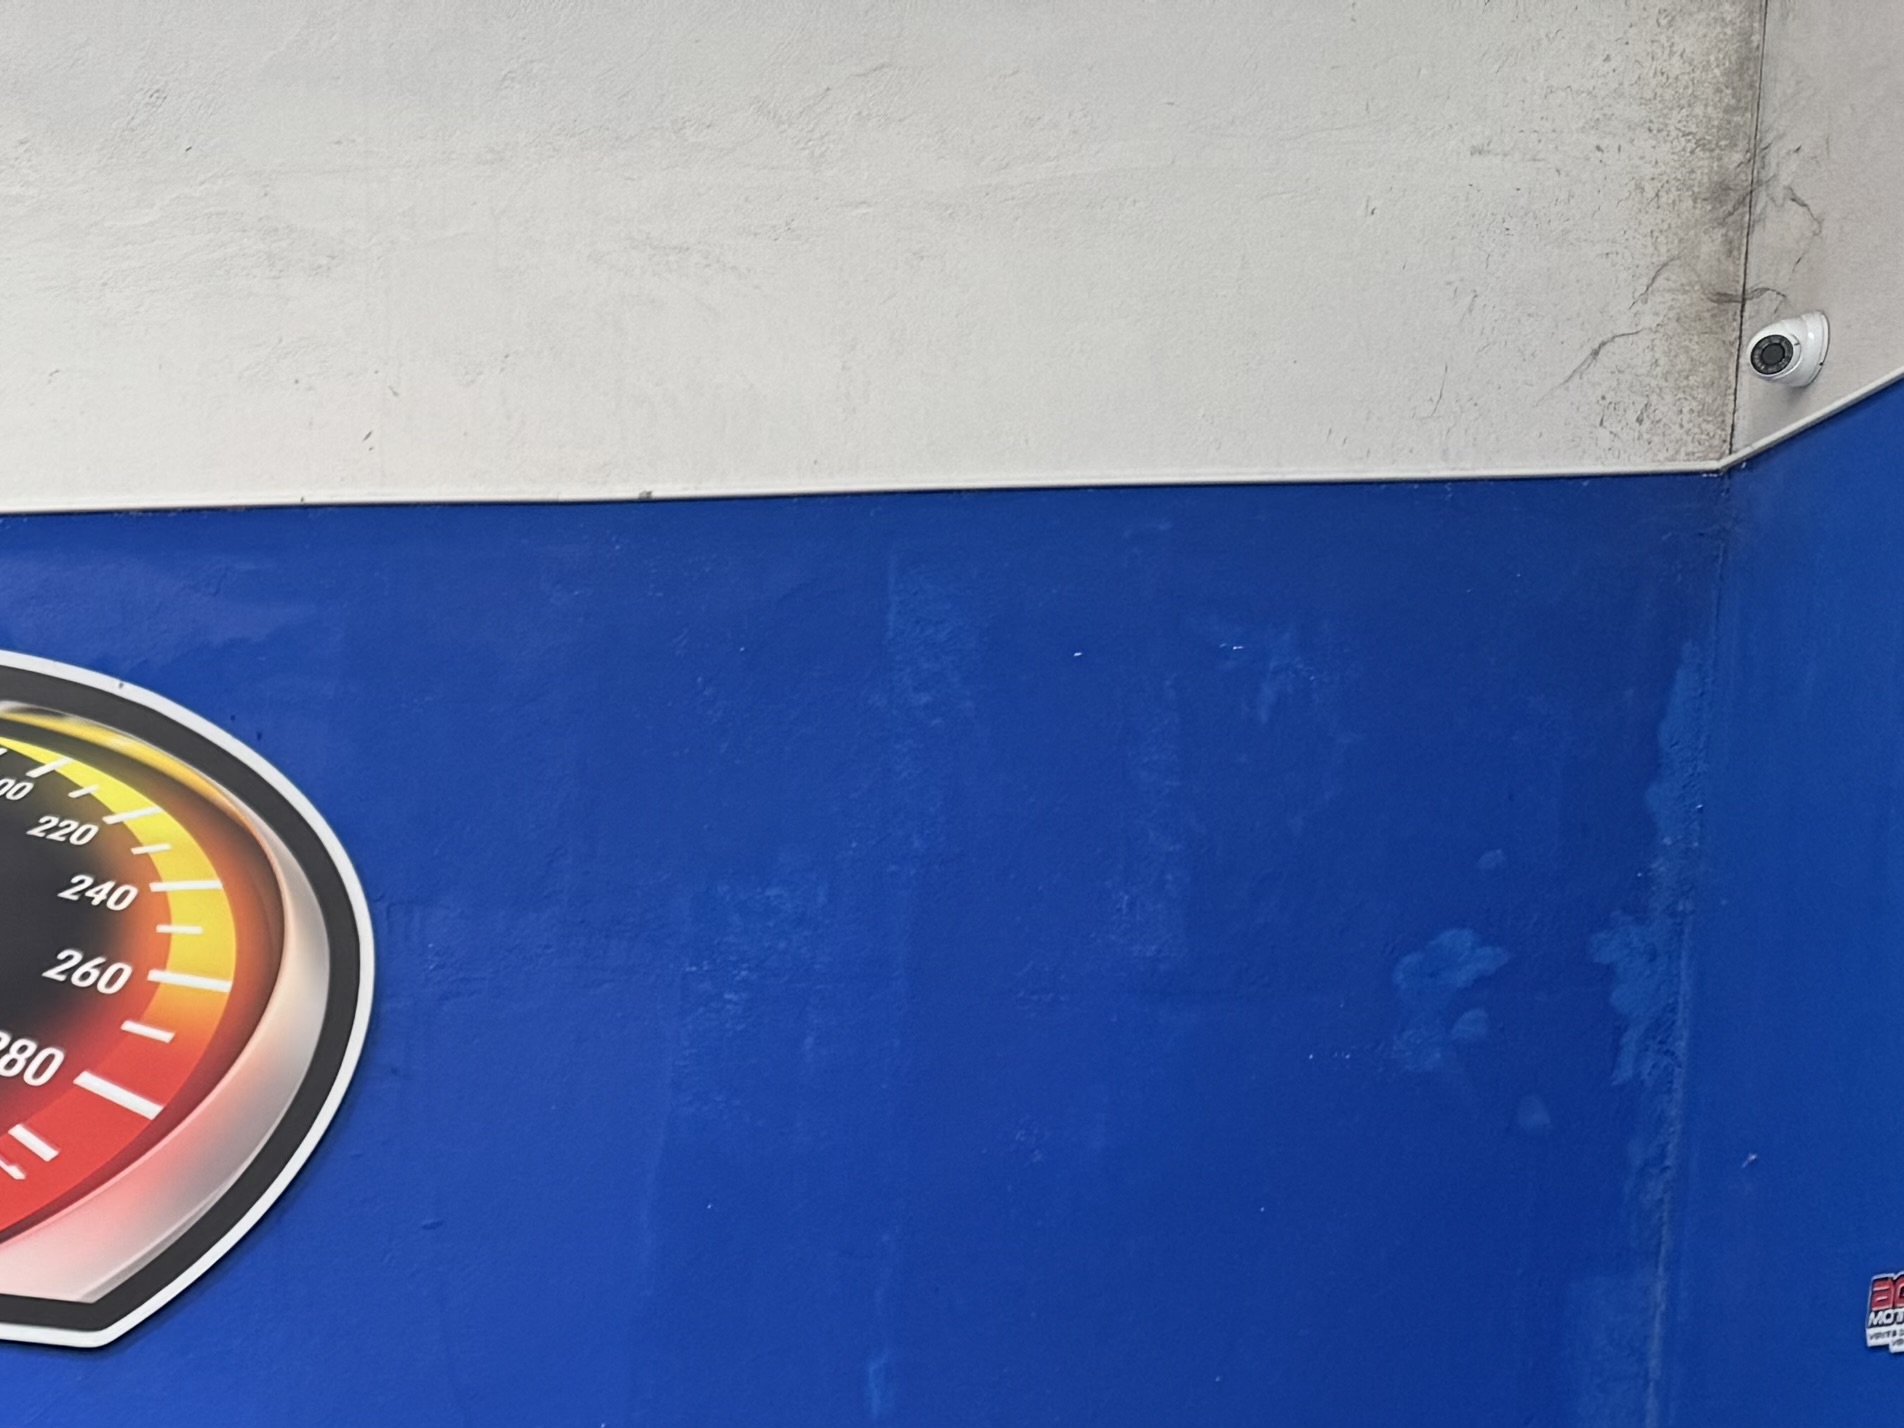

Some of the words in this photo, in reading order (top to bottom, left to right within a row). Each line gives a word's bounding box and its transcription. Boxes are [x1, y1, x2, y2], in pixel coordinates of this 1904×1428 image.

[26, 815, 99, 846] 220
[58, 873, 138, 911] 240
[41, 948, 132, 995] 260
